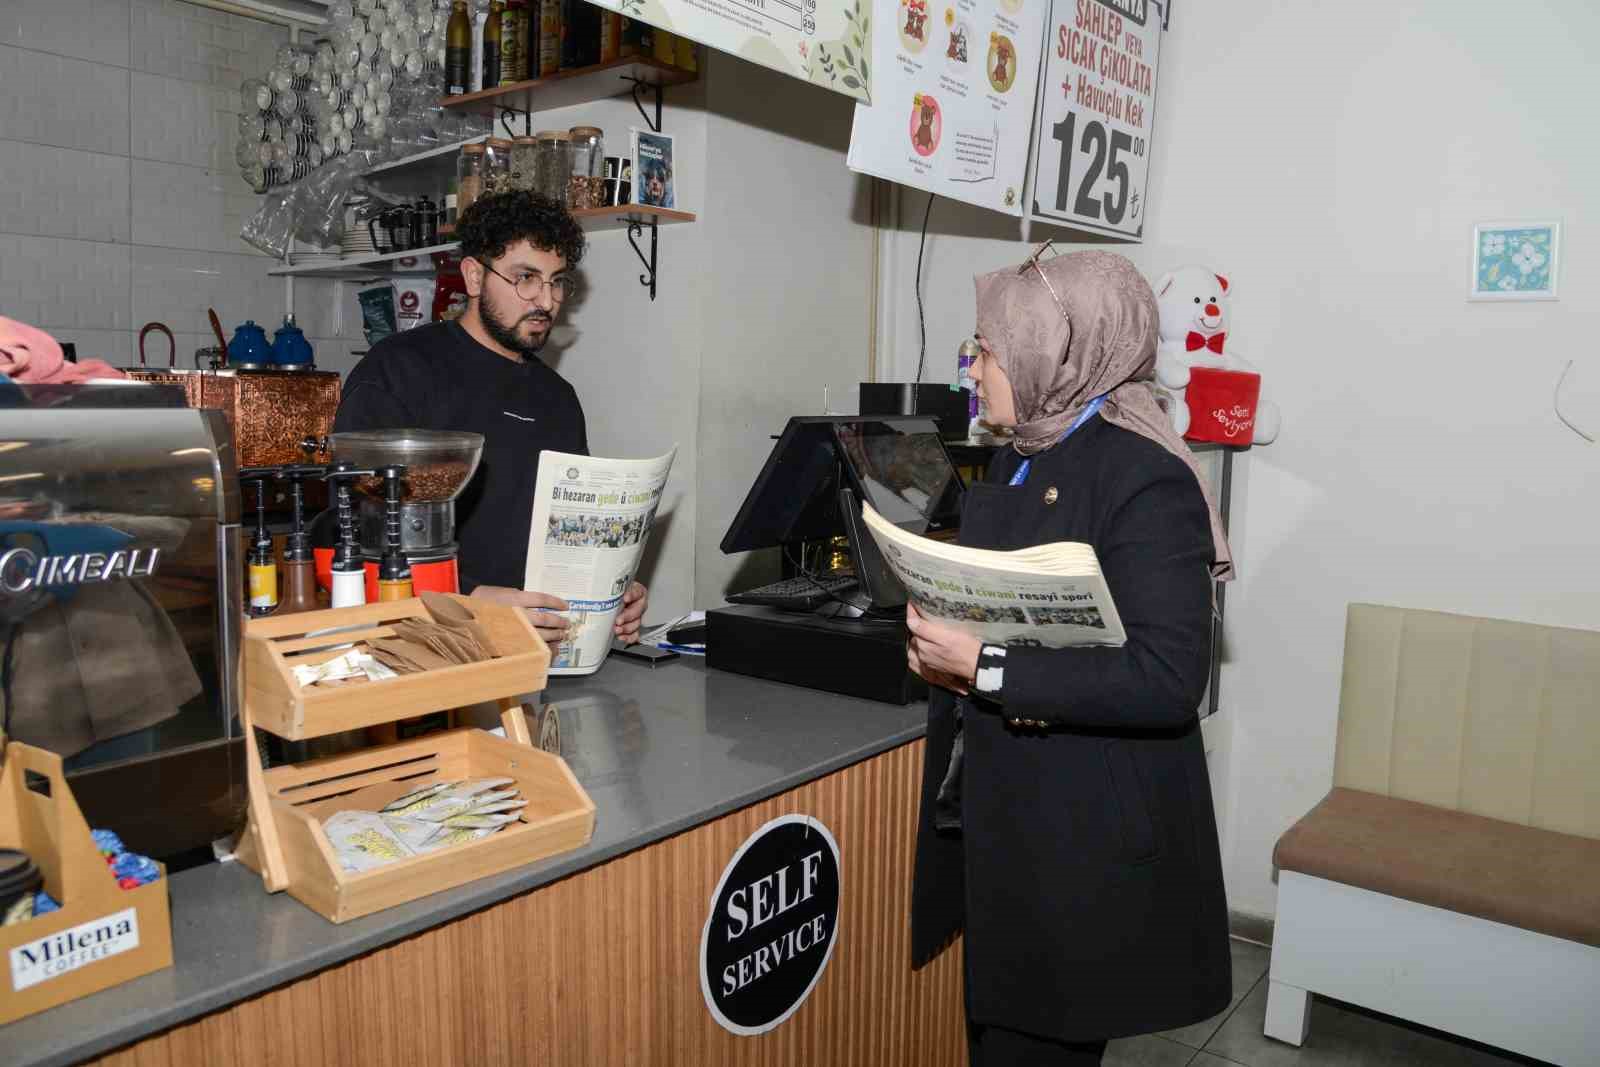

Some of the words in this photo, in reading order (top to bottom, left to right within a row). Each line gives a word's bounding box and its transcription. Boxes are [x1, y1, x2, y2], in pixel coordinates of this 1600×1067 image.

[1058, 24, 1098, 72] SICAK
[1075, 0, 1122, 46] SAHLEP
[1061, 74, 1072, 99] +
[1077, 74, 1122, 124] Havuçlu
[1124, 95, 1144, 128] Kek
[1052, 111, 1132, 225] 125
[1133, 136, 1145, 157] 00
[552, 487, 560, 500] Bi
[562, 488, 596, 504] hezaran
[0, 548, 160, 592] CIMBALI
[727, 850, 823, 942] SELF
[20, 918, 132, 971] Milena
[43, 942, 112, 976] COFFEE
[722, 914, 826, 998] SERVICE
